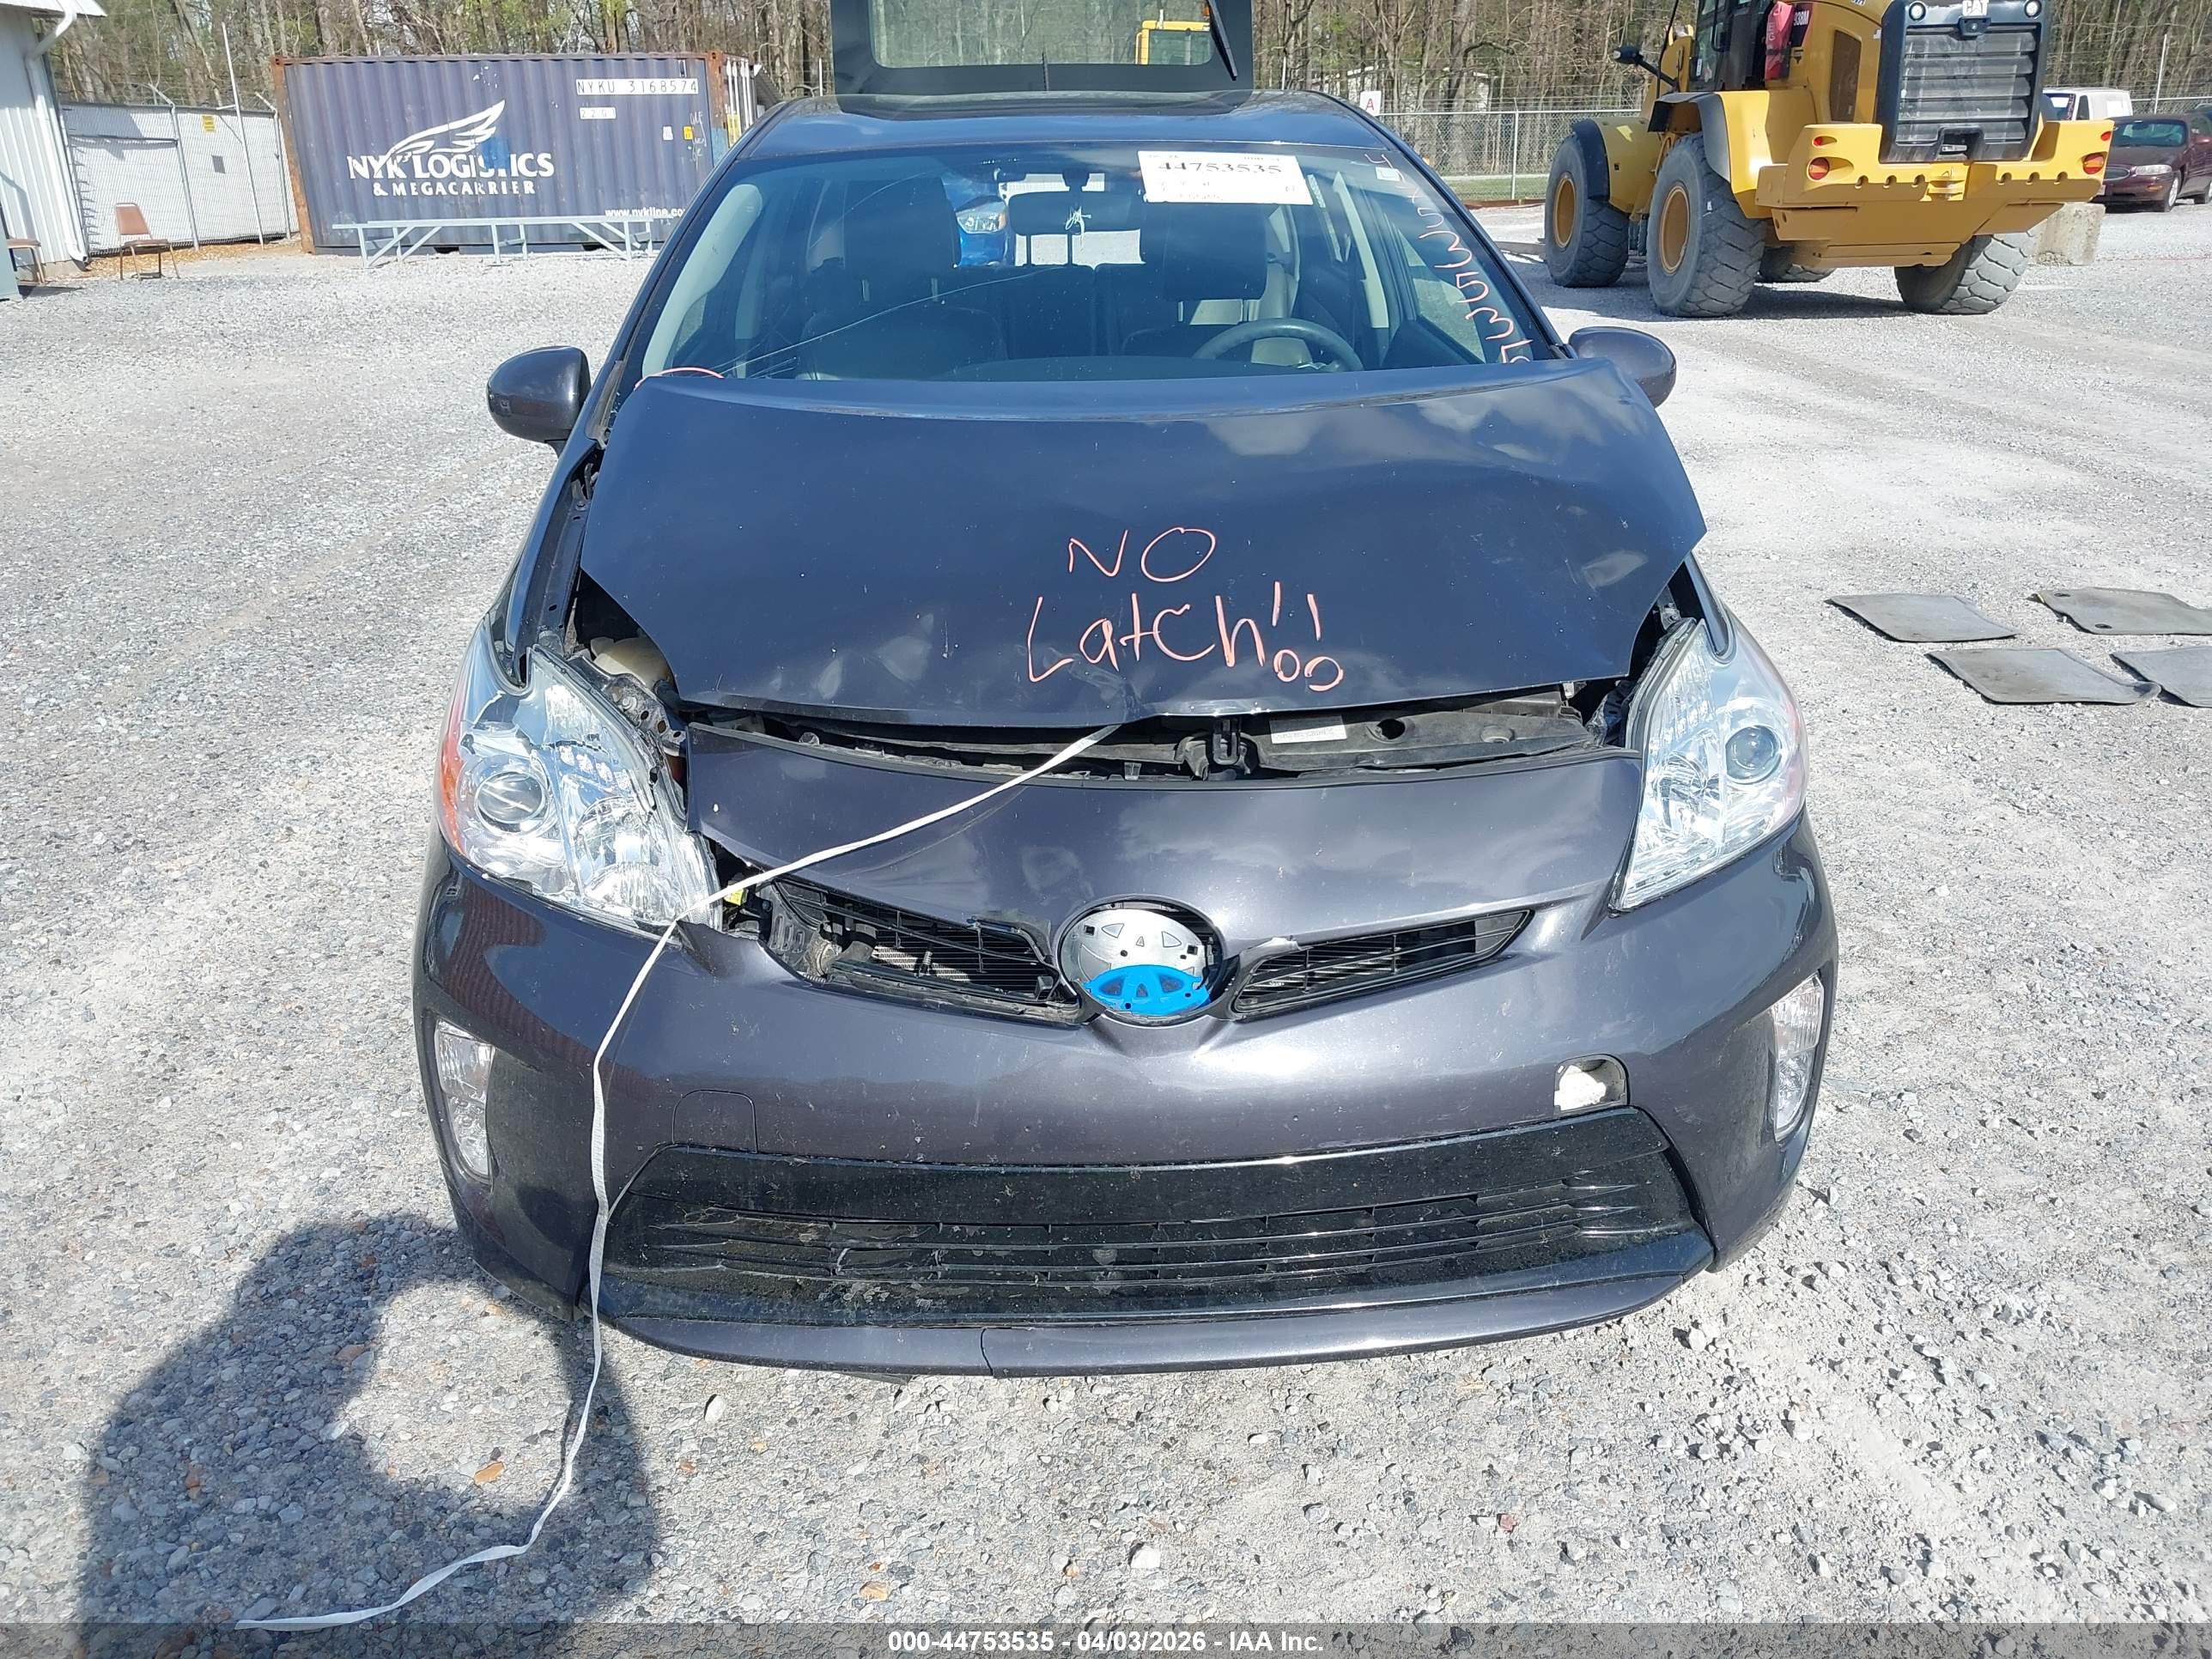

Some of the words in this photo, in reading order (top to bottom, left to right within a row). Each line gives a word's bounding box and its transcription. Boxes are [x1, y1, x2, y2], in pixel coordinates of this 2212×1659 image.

[1962, 0, 1989, 16] CAT
[577, 80, 615, 94] NYKU
[629, 80, 697, 94] 3168574
[1365, 98, 1375, 110] A
[1158, 161, 1282, 174] 44753535
[373, 180, 388, 197] &
[392, 179, 536, 196] MEGACARRIER
[1067, 526, 1217, 583] NO
